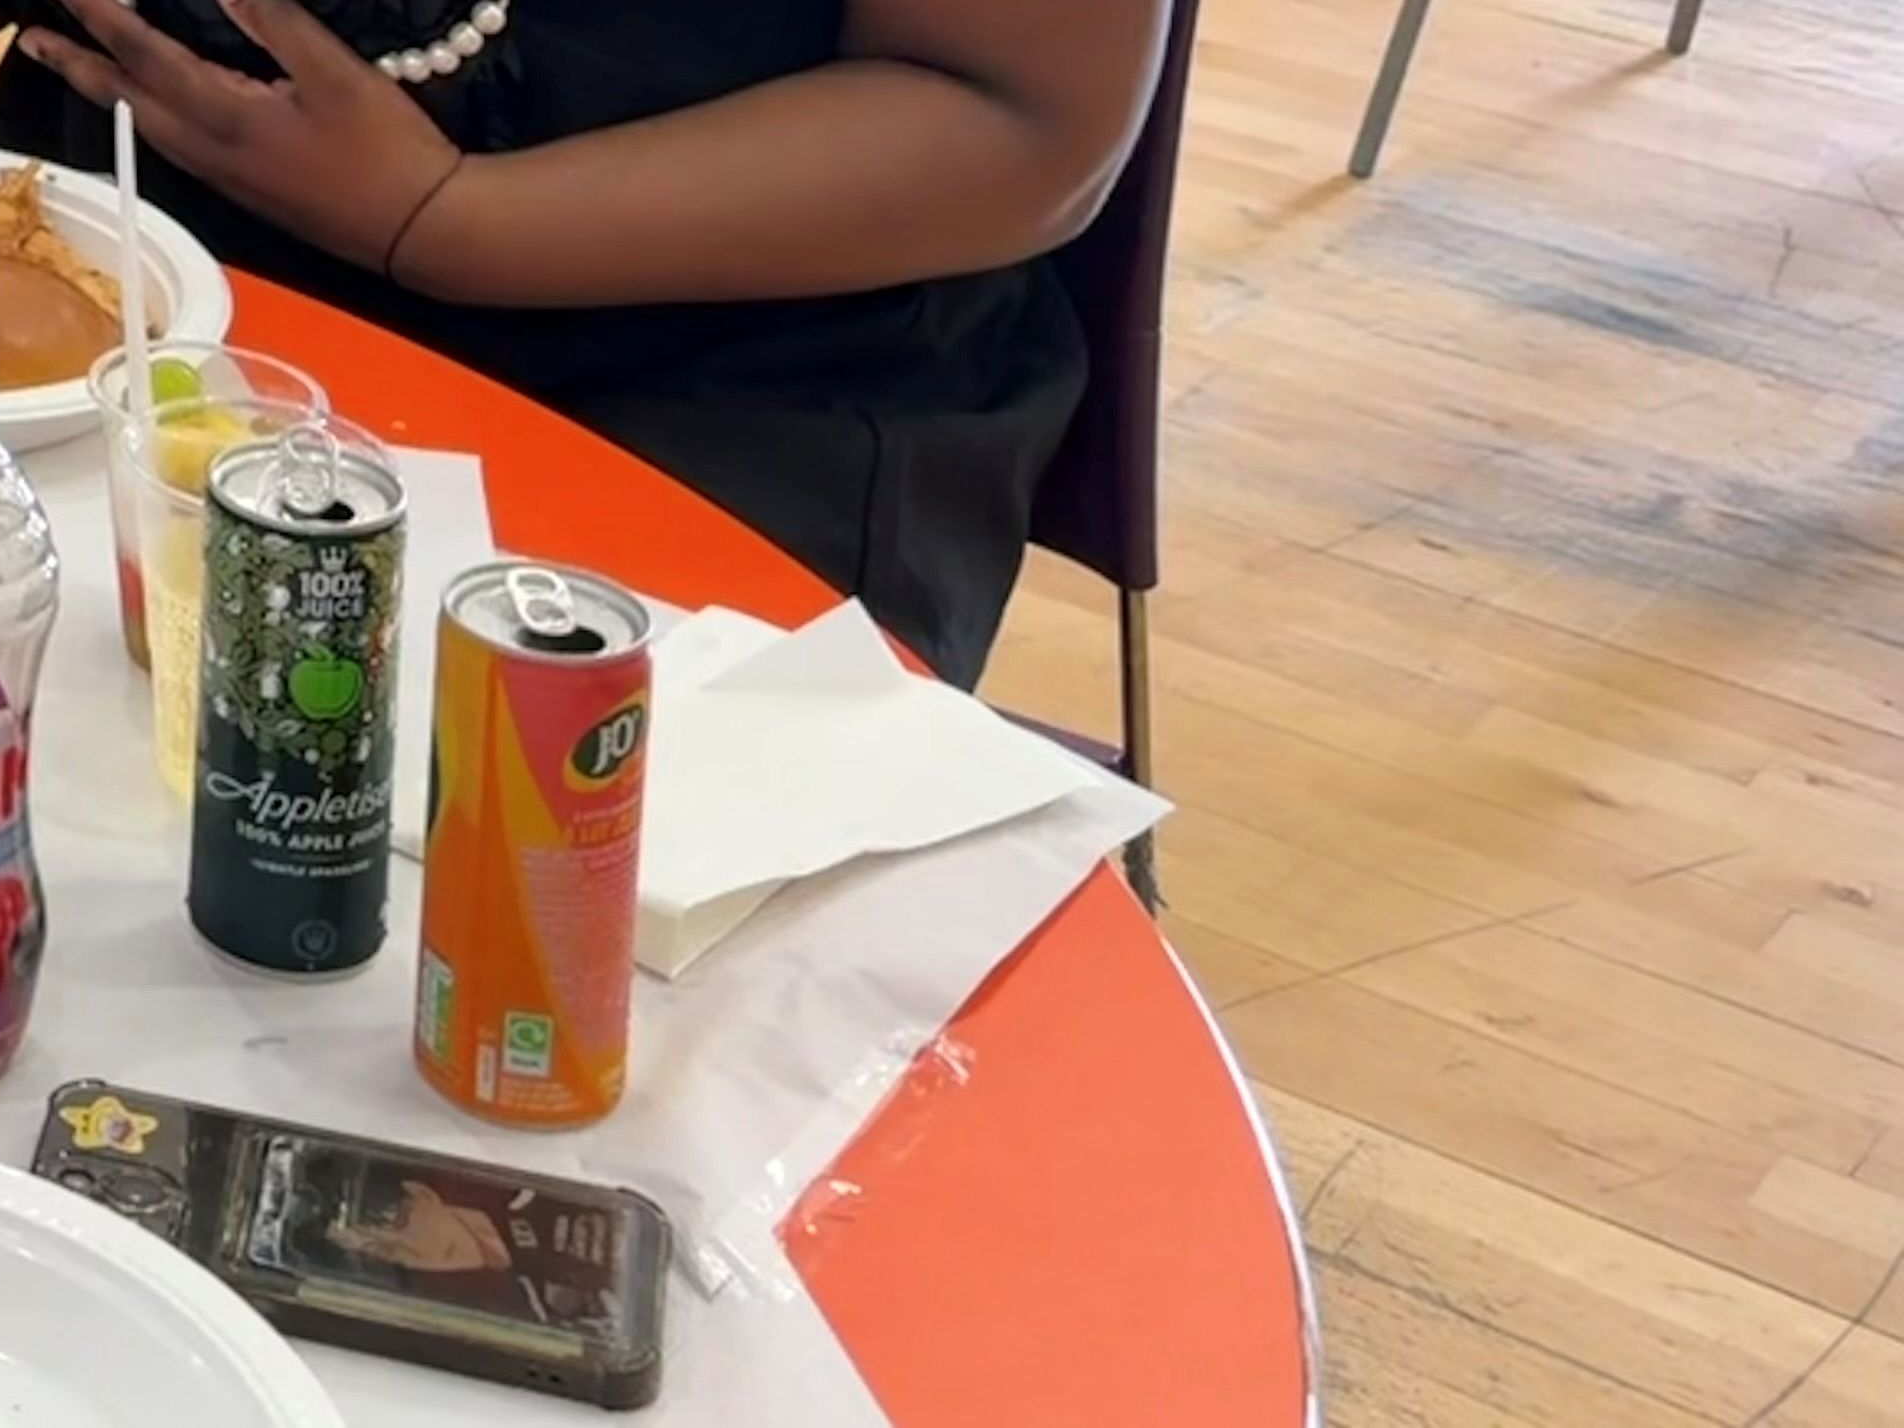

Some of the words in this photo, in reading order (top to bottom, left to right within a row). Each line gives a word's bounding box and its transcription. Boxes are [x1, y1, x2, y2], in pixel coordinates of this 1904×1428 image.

[297, 571, 366, 599] 100%
[295, 599, 365, 619] JUICE
[205, 770, 390, 829] Appletise
